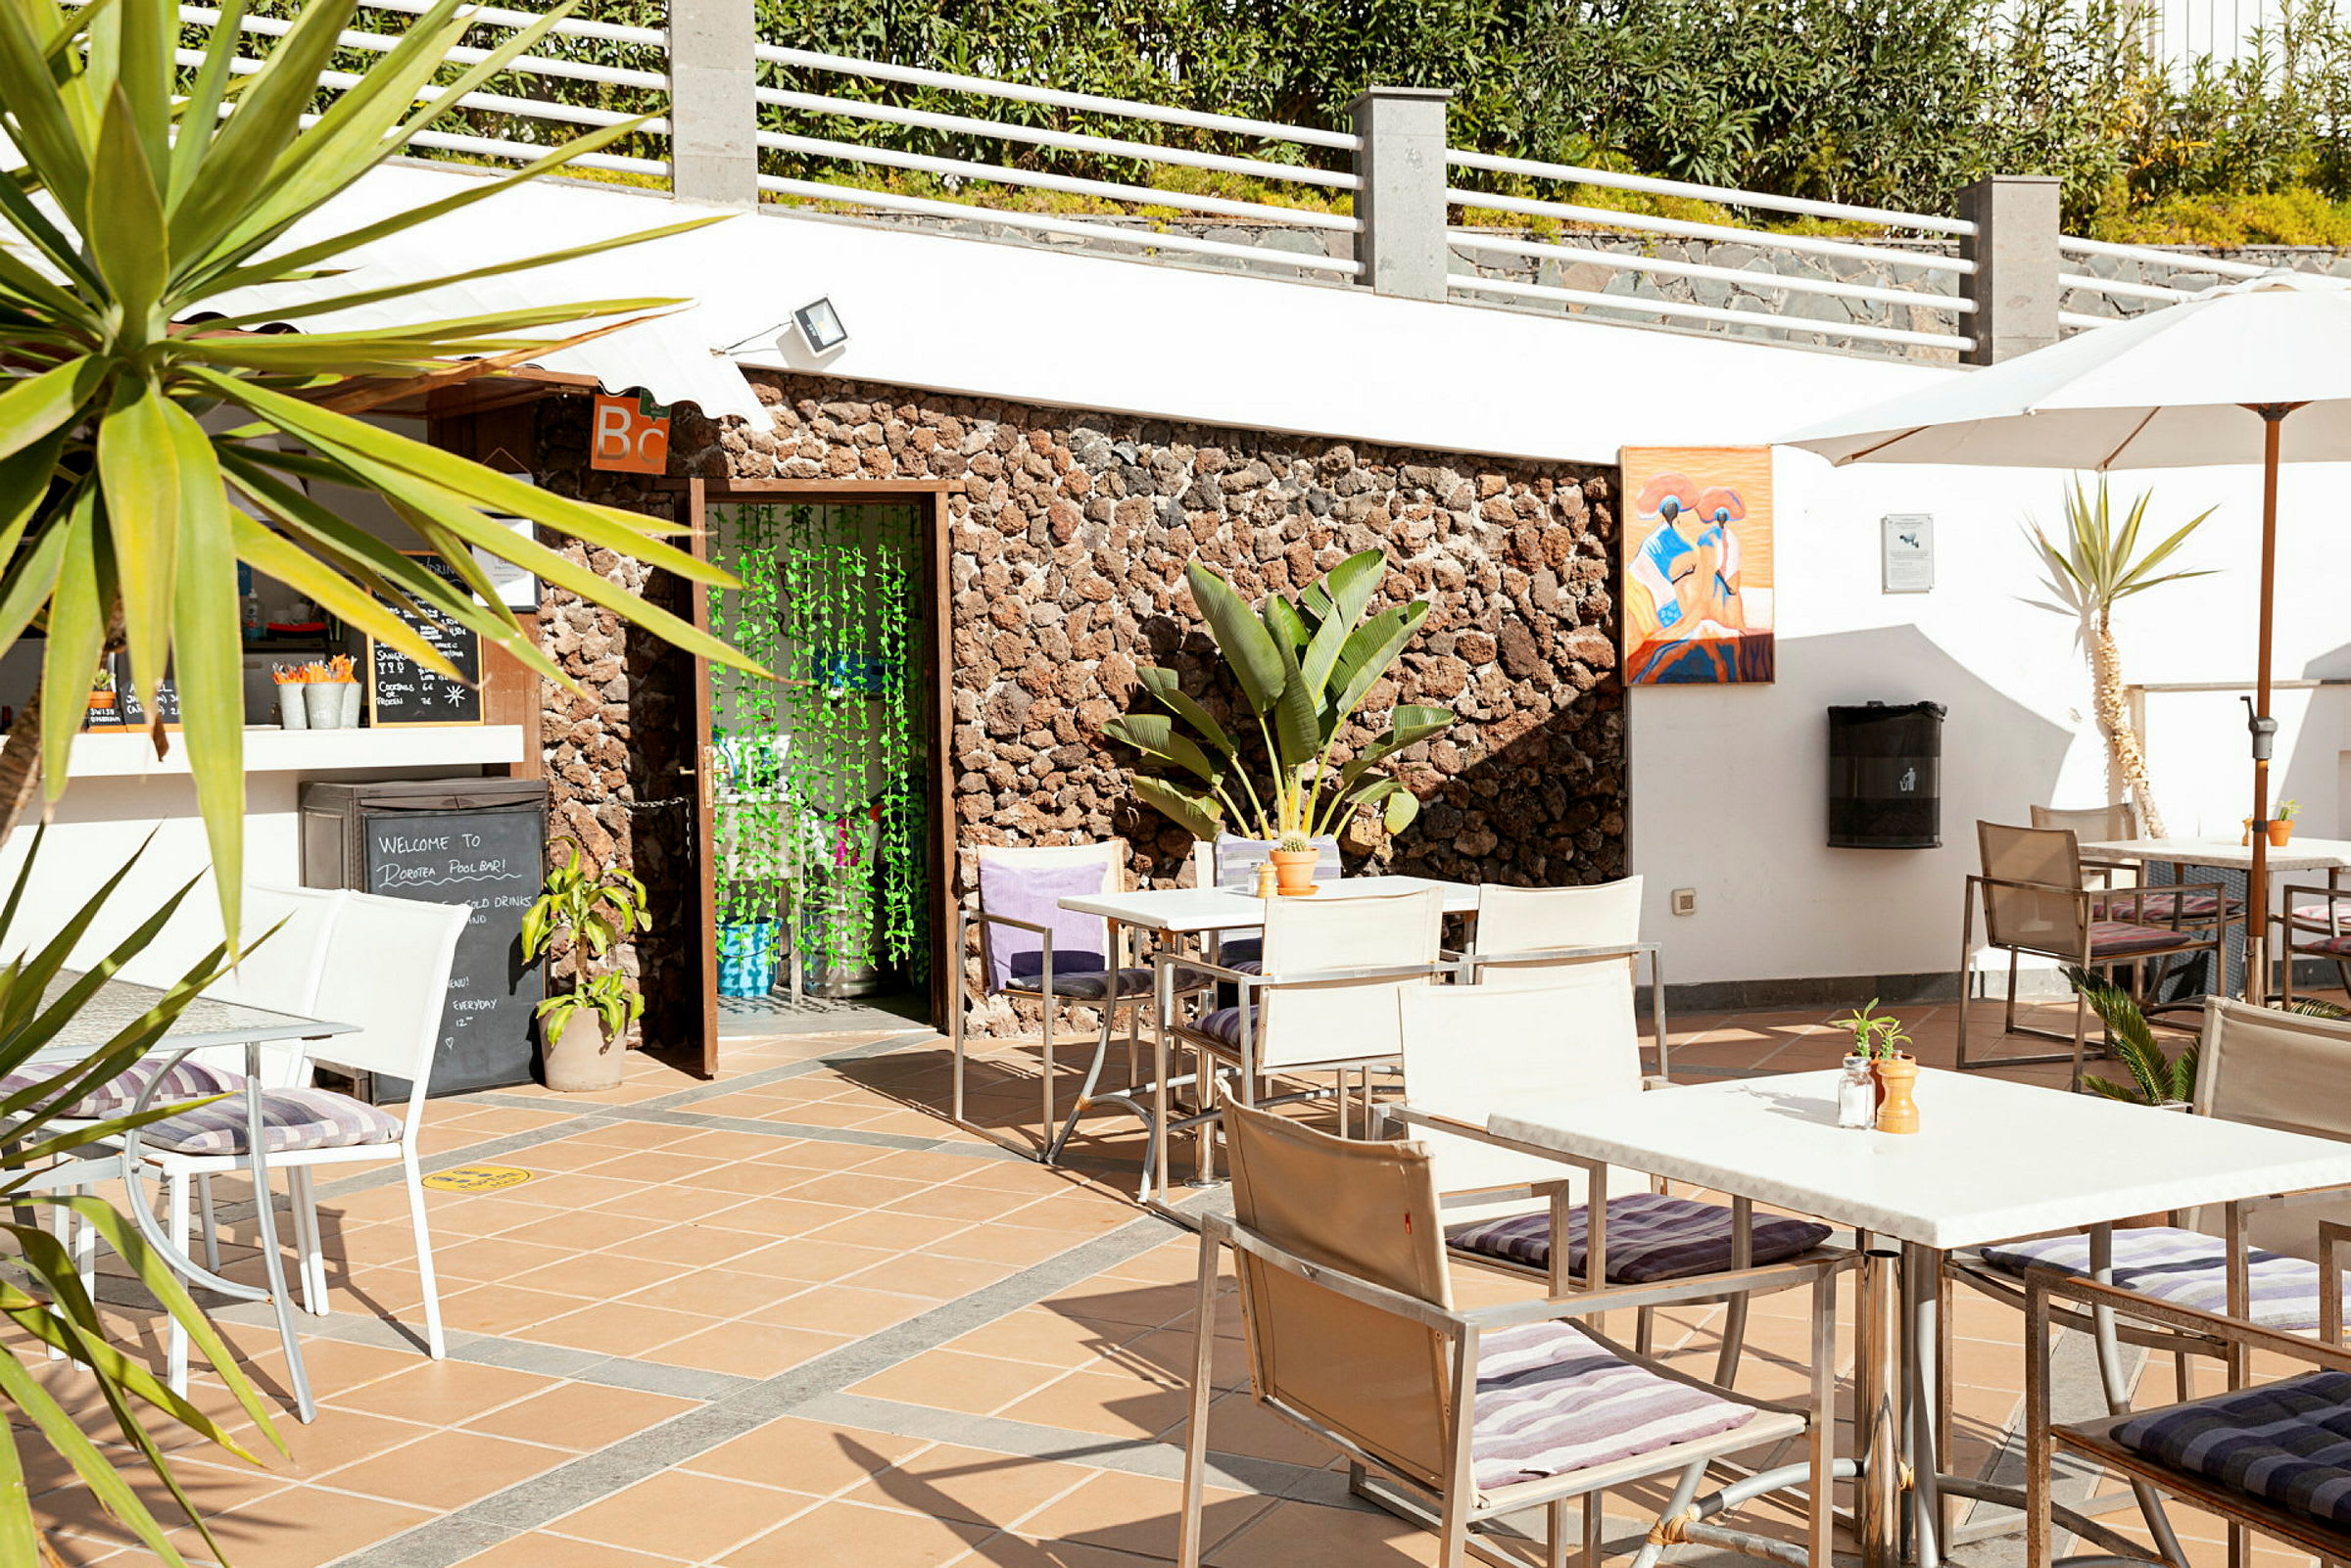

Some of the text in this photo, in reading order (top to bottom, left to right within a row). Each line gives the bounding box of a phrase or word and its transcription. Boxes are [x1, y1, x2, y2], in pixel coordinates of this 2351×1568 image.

[378, 833, 481, 854] WELCOME TO
[449, 975, 470, 989] ENU!
[453, 999, 498, 1011] EVERYDAY
